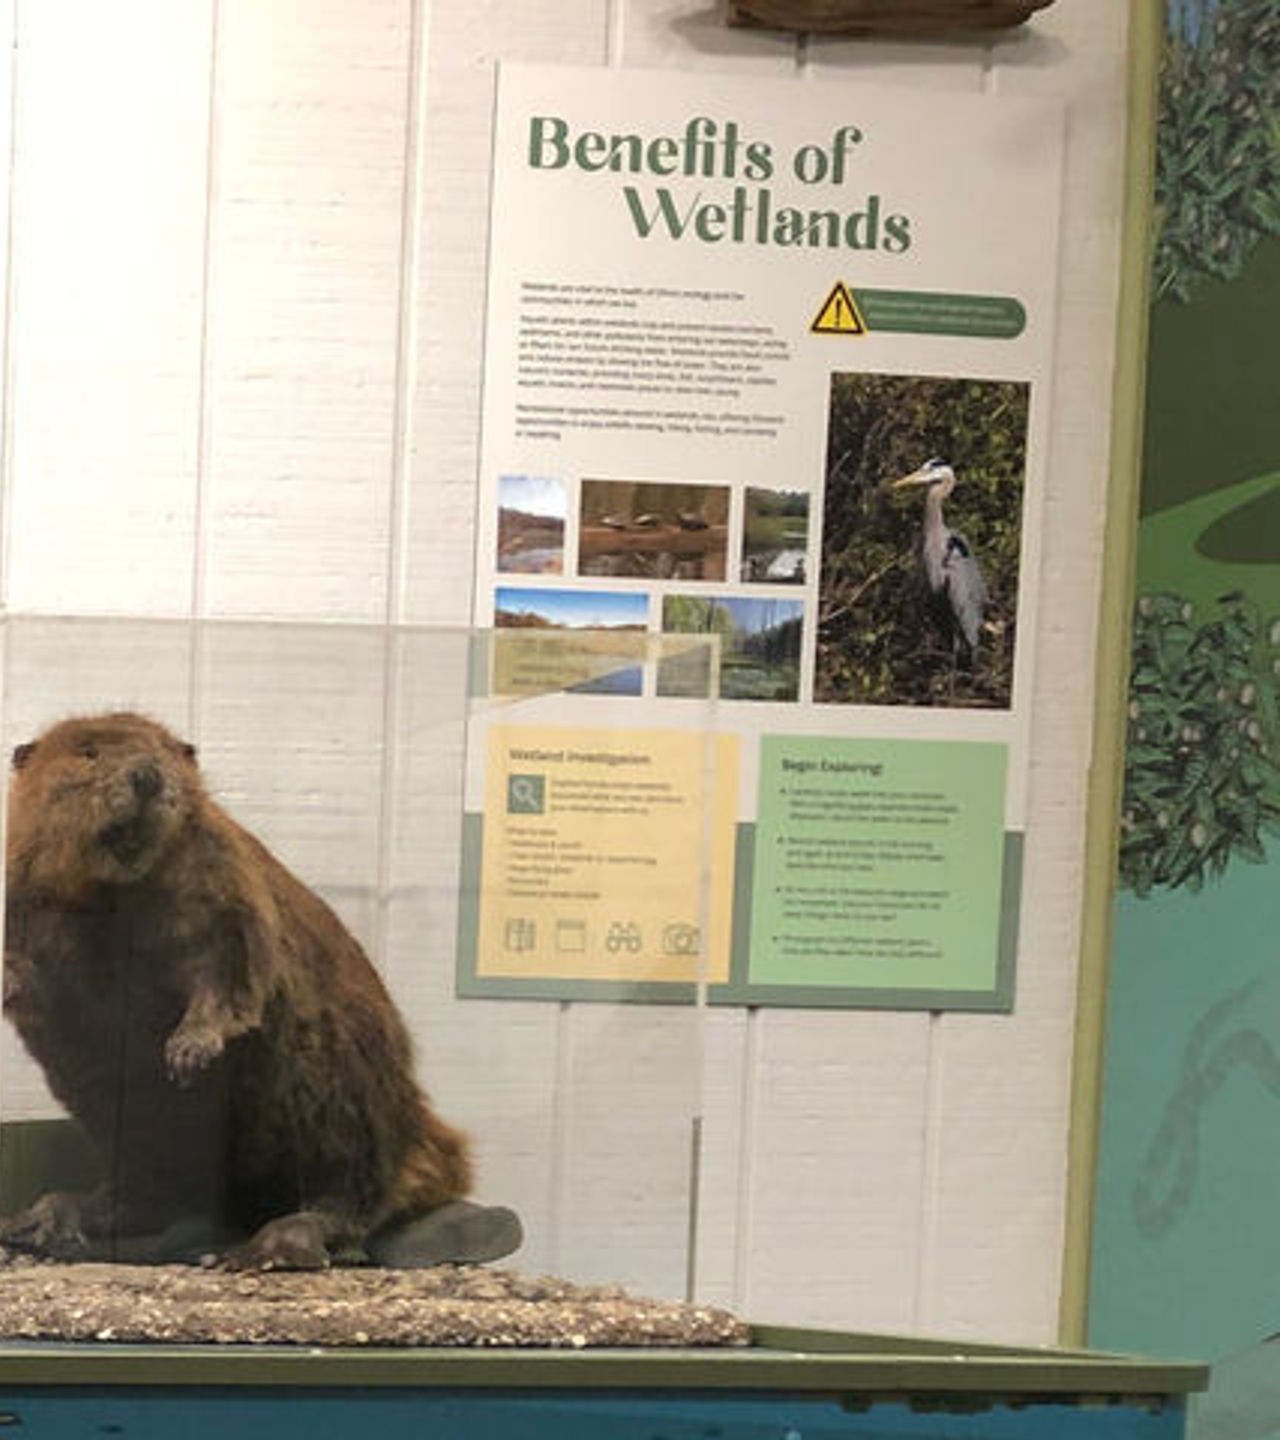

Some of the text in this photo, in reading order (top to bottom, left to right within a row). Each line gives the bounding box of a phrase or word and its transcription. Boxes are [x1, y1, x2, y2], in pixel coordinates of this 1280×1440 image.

[528, 116, 863, 185] Benefits of
[623, 186, 912, 254] Wetlands
